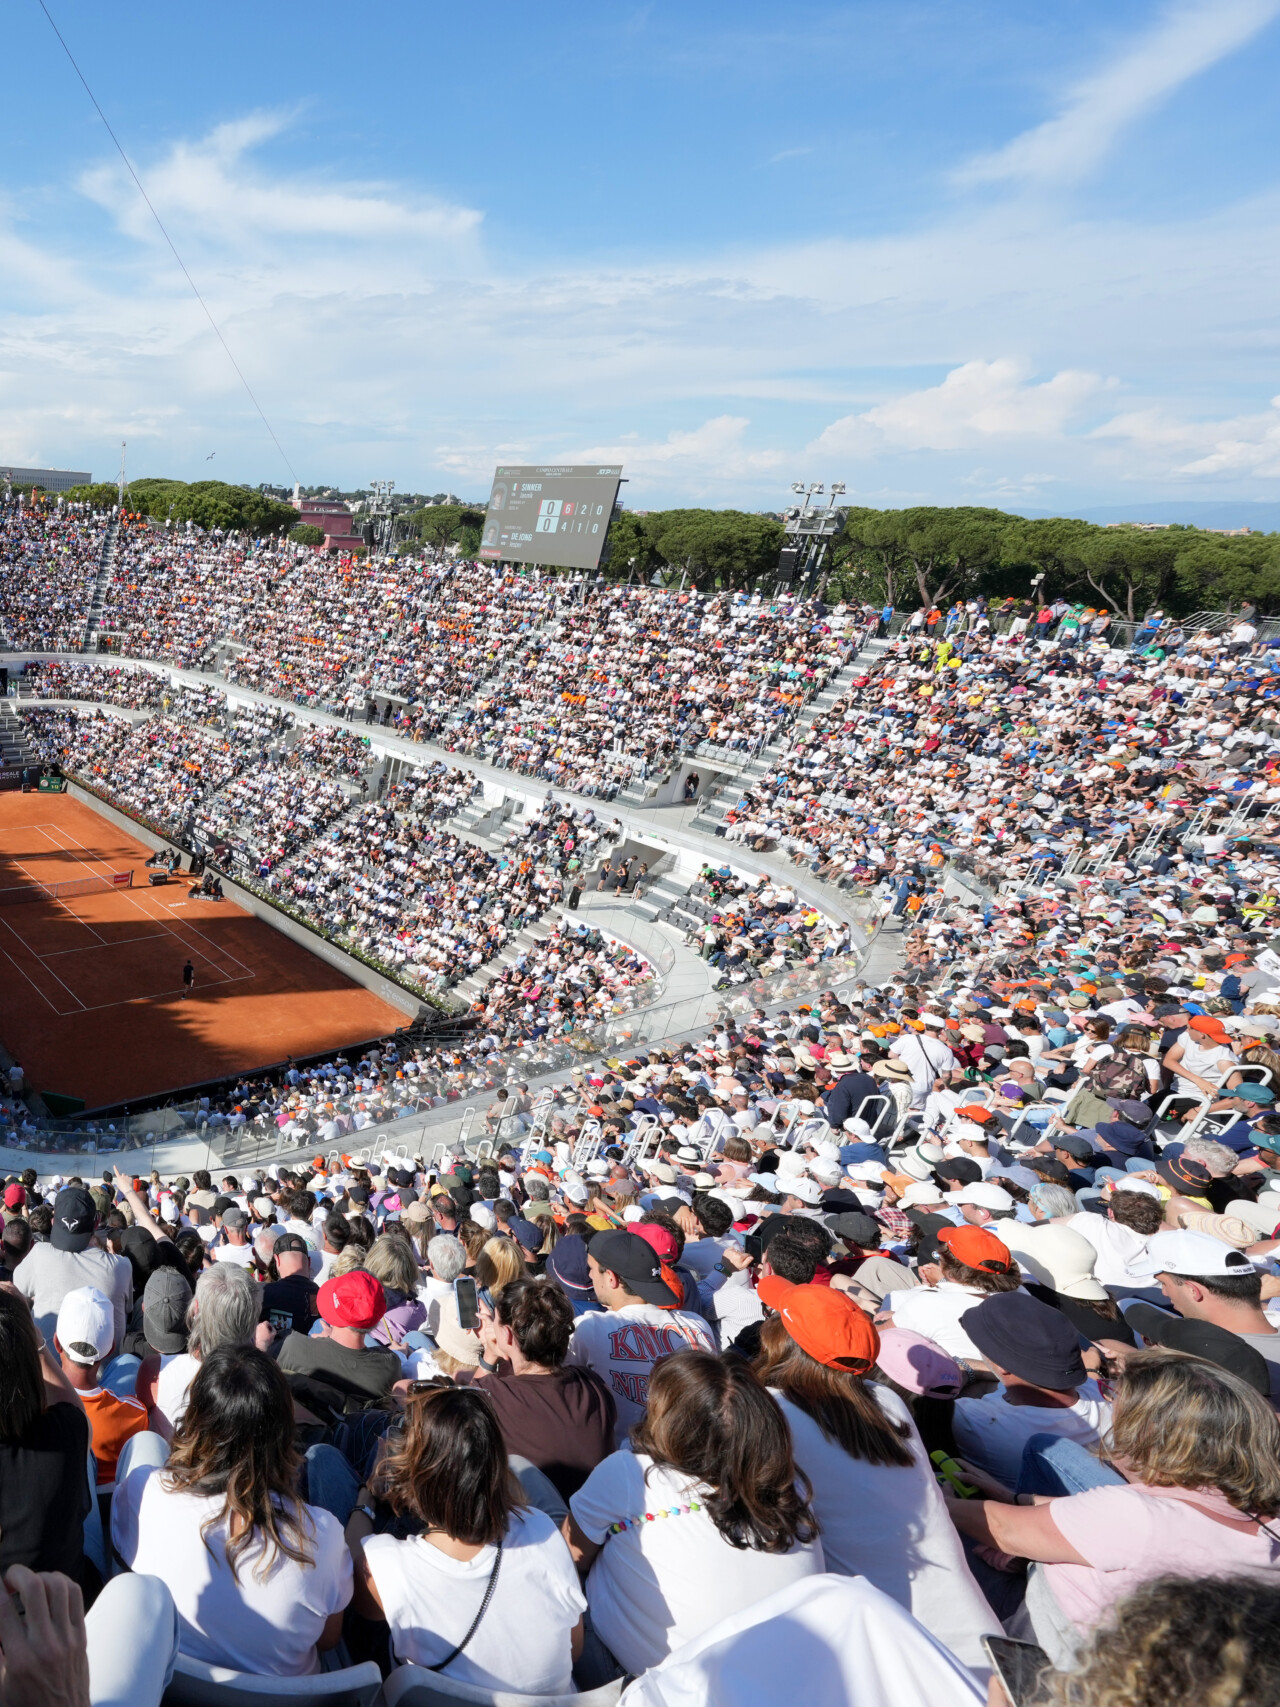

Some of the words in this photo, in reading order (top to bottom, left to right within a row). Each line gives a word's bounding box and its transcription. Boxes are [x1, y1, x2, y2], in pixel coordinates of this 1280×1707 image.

[547, 501, 555, 515] 0
[565, 504, 571, 513] 6
[581, 505, 587, 514] 2
[597, 505, 603, 515] 0
[543, 518, 550, 531] 0
[561, 522, 567, 532] 4
[578, 523, 582, 532] 1
[592, 524, 598, 533] 0
[518, 533, 532, 541] JONG
